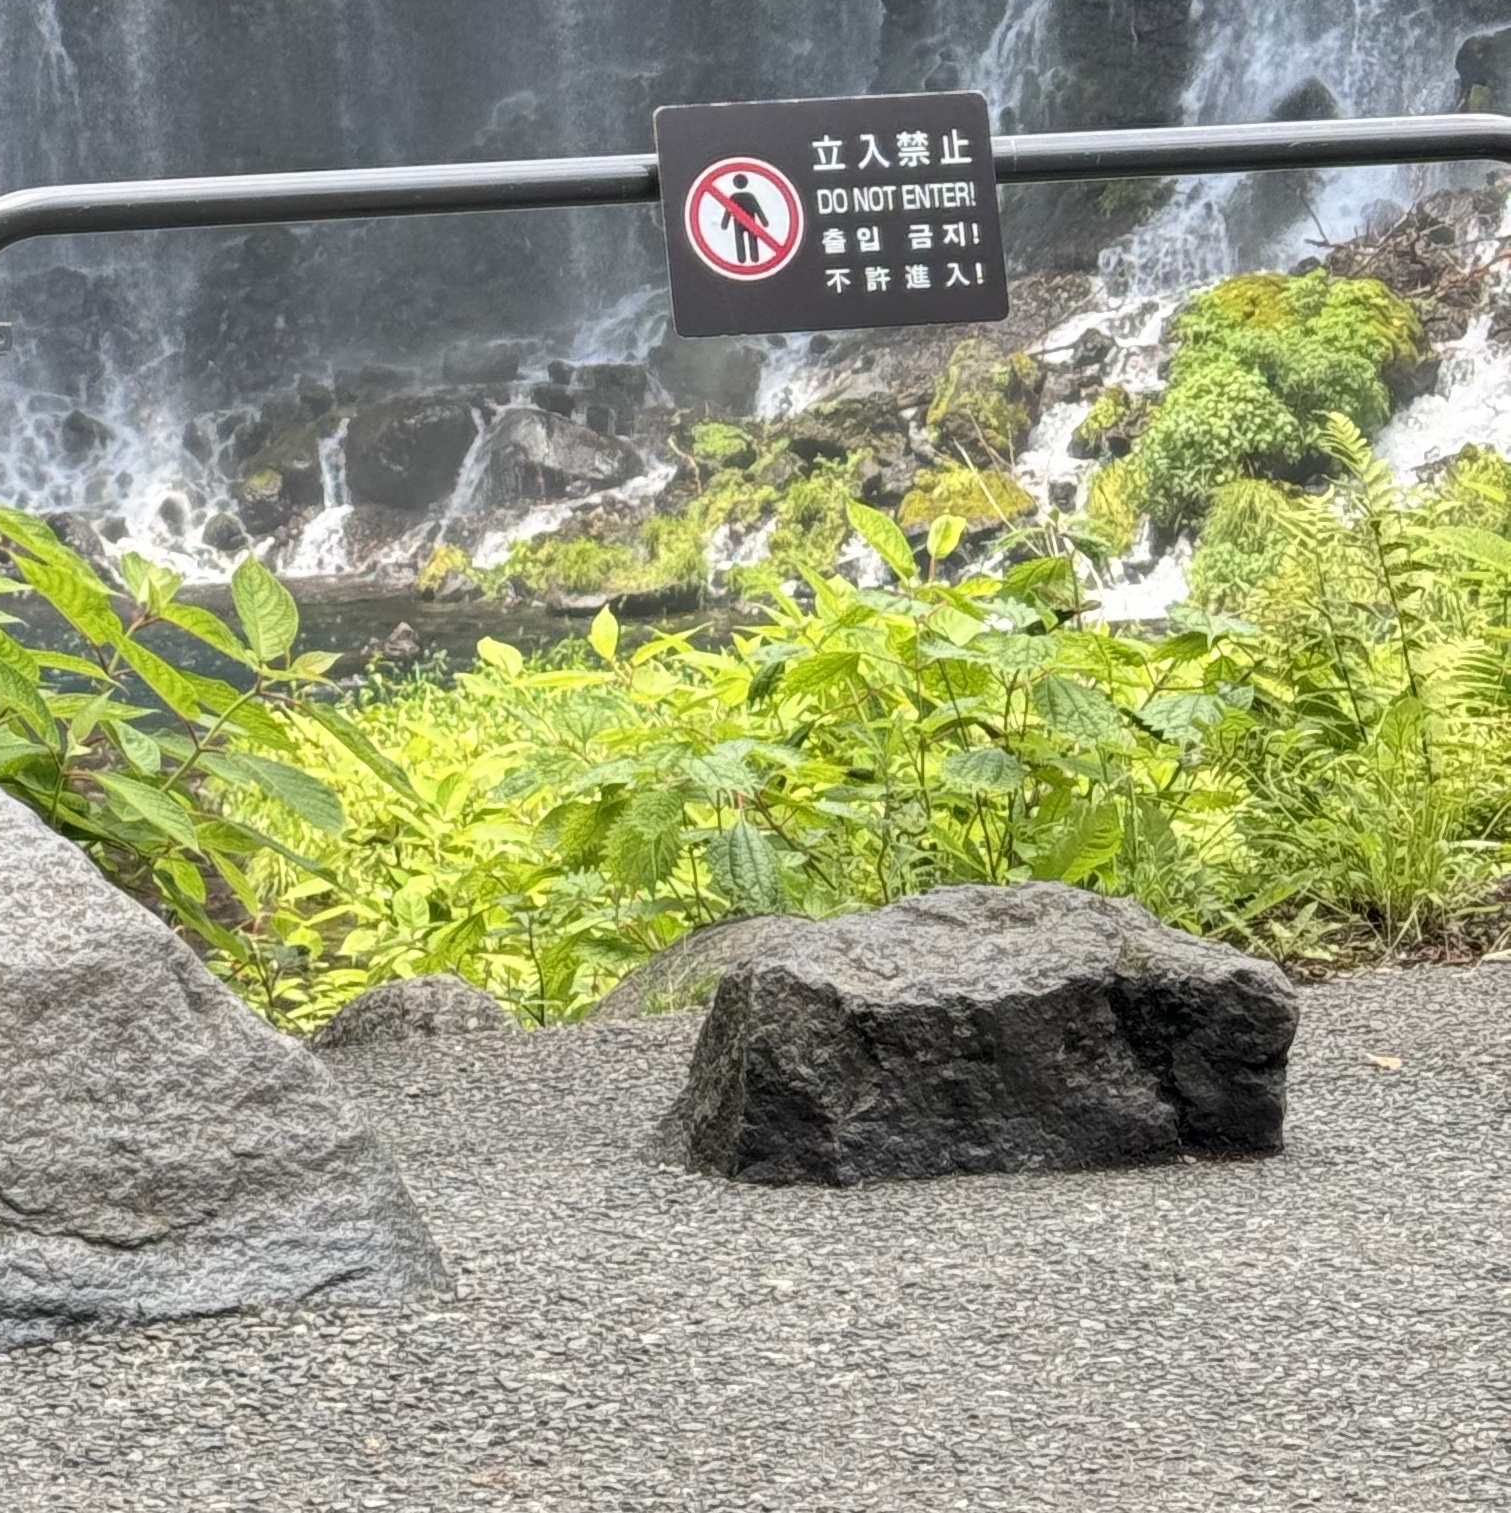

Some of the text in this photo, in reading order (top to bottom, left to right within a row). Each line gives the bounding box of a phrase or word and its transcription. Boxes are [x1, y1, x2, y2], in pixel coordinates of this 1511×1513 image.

[811, 128, 973, 171] 立入禁止
[816, 180, 977, 215] DO NOT ENTER!
[821, 221, 981, 254] 출입 금지!
[824, 262, 985, 294] 不許進入!
